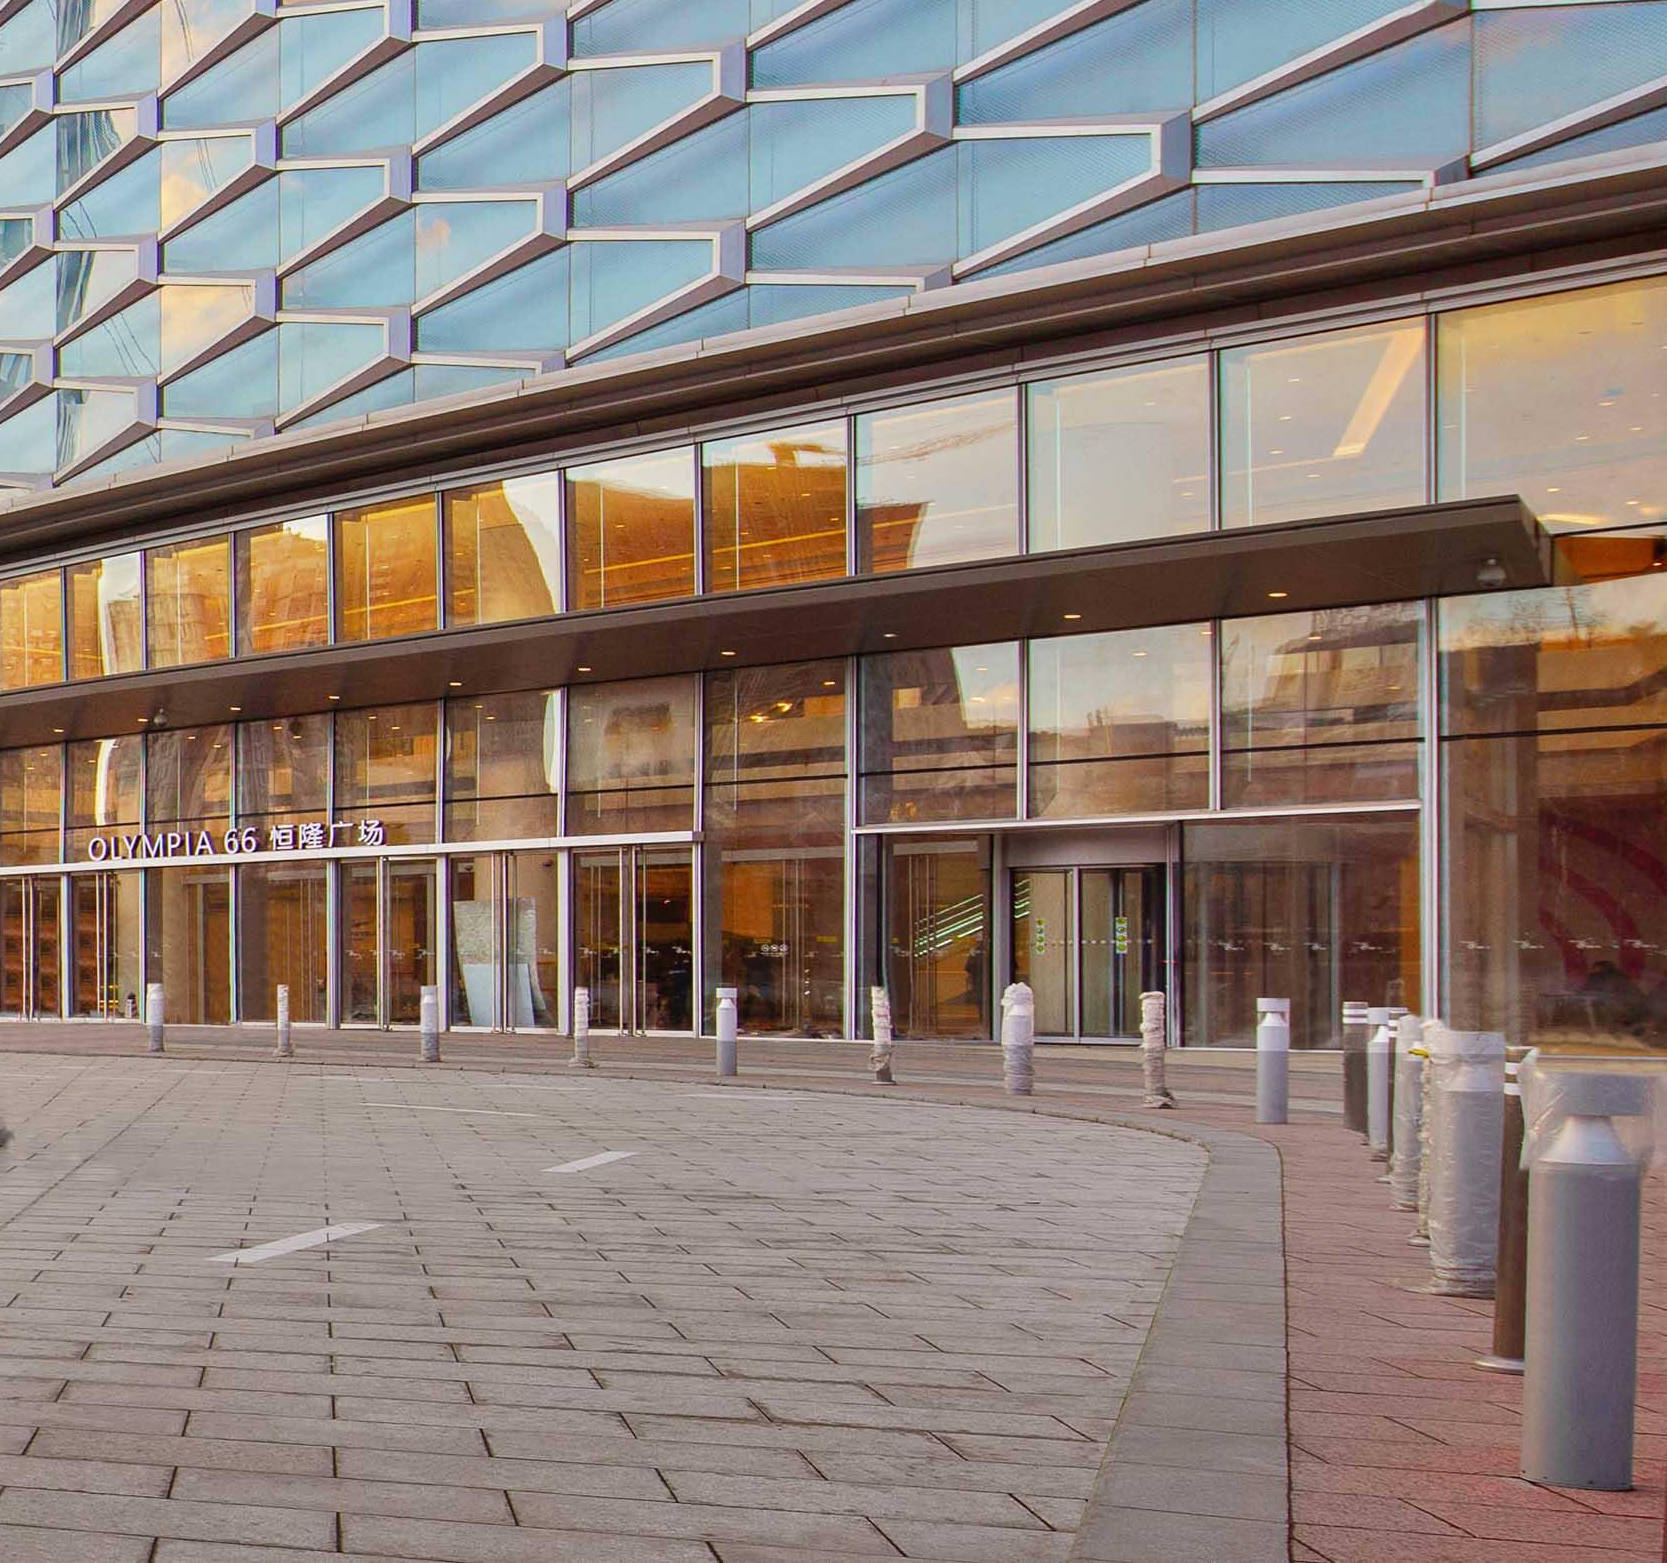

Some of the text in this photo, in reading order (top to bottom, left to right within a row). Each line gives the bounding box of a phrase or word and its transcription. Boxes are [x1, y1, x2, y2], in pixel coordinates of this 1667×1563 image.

[87, 819, 387, 862] OLYMPIA 66 恒隆广场
